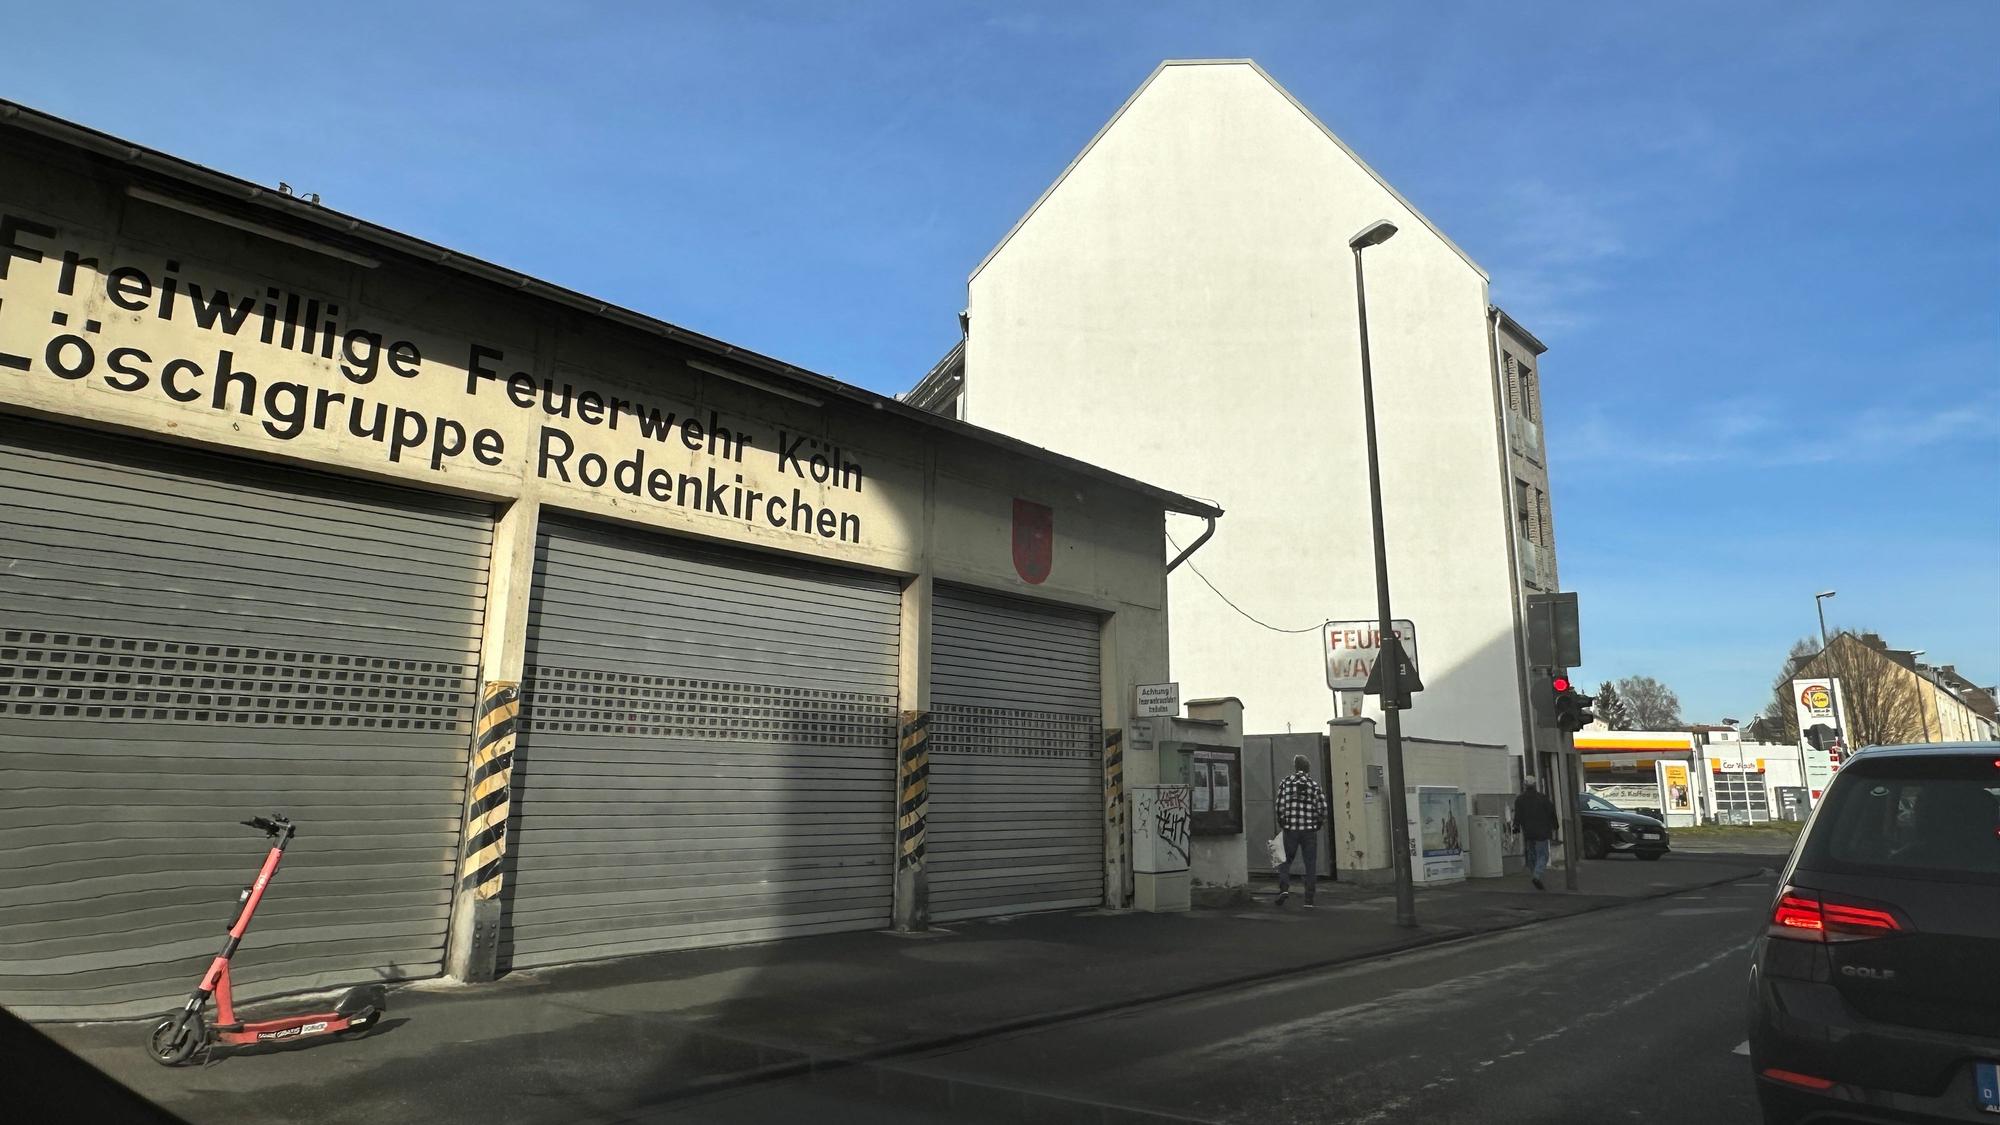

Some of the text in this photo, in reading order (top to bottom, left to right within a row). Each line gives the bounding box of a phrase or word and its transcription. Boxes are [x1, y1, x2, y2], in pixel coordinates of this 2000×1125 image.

[0, 214, 863, 493] Freiwillige Feuerwehr Köln
[537, 425, 861, 544] Rodenkirchen
[1841, 965, 1895, 980] GOLF
[1983, 1088, 1992, 1099] D
